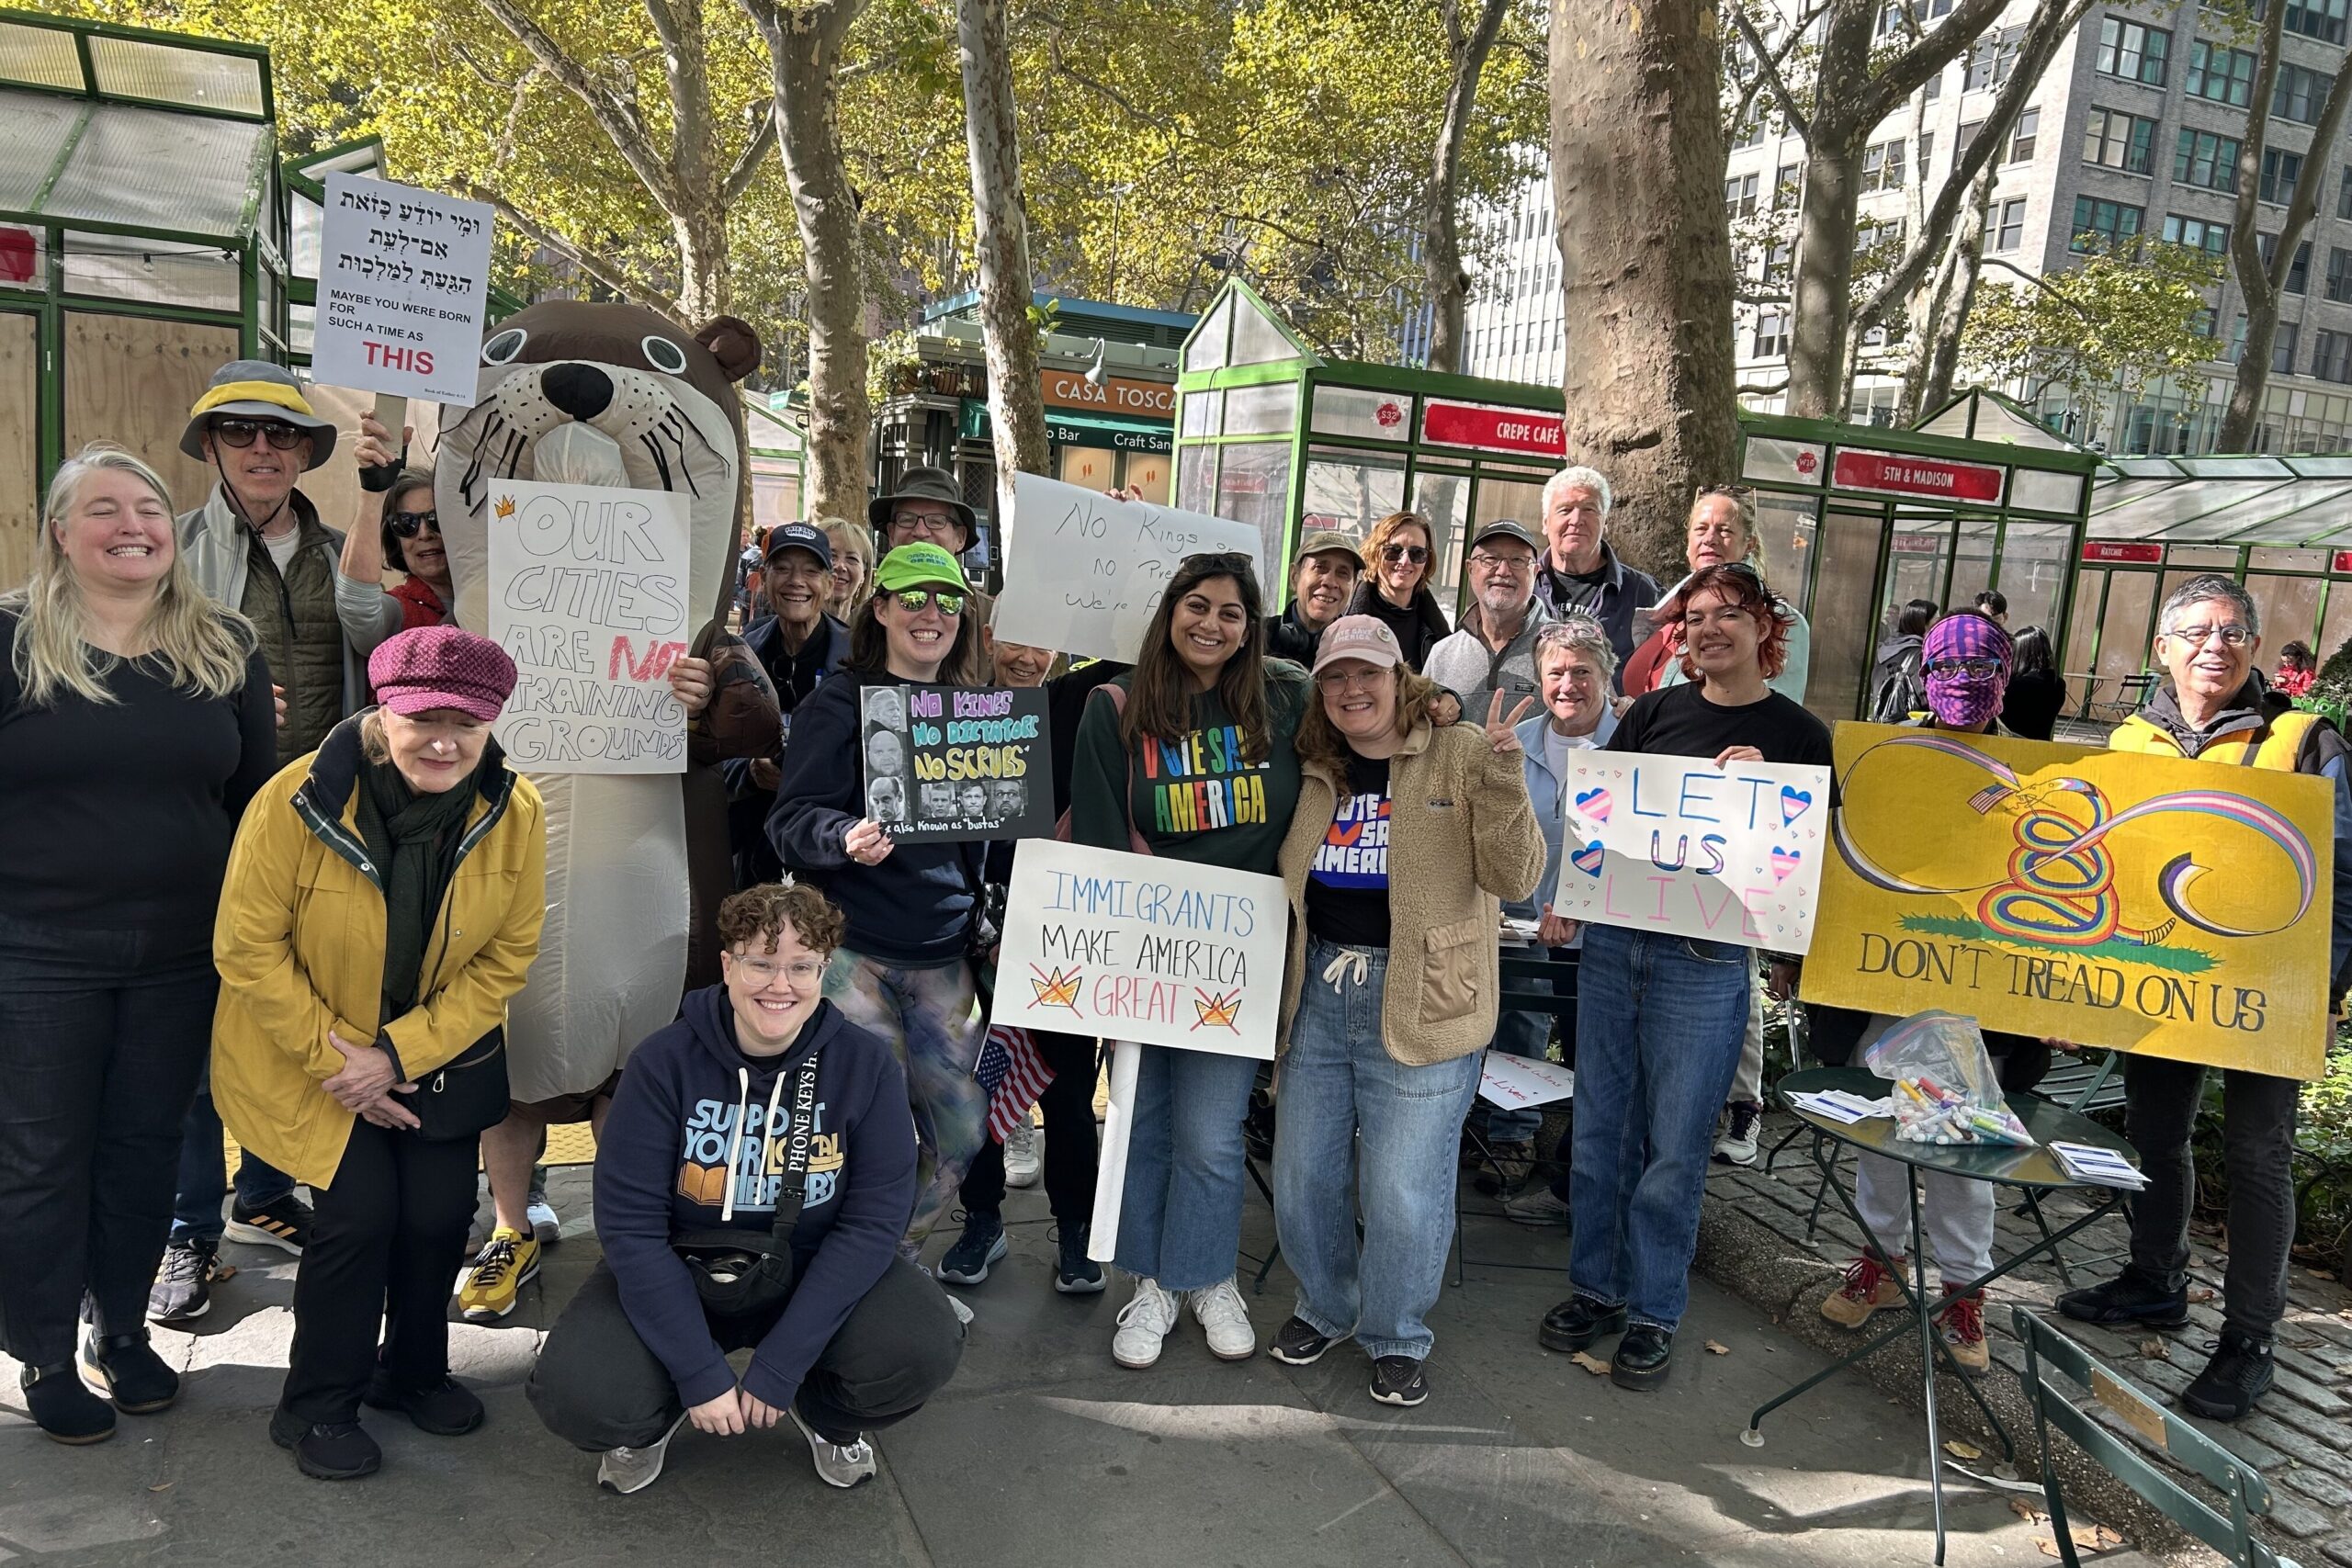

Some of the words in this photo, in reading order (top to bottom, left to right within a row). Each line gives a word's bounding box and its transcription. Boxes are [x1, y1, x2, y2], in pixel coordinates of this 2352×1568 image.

[329, 302, 356, 315] FOR
[331, 289, 371, 305] MAYBE
[374, 298, 399, 310] YOU
[402, 303, 435, 317] WERE
[439, 310, 471, 323] BORN
[328, 317, 362, 331] SUCH
[365, 323, 374, 333] A
[377, 324, 404, 338] TIME
[407, 331, 424, 342] AS
[362, 341, 435, 375] THIS
[1056, 380, 1107, 403] CASA
[1058, 427, 1080, 441] Bar
[1381, 411, 1397, 421] S32
[1497, 422, 1530, 441] CREPE
[1532, 425, 1559, 445] CAFÉ
[1114, 434, 1146, 448] Craft
[1148, 437, 1173, 450] San
[1883, 466, 1902, 482] 5TH
[1904, 469, 1911, 483] &
[1913, 469, 1954, 488] MADISON
[517, 494, 664, 564] OUR
[1055, 499, 1107, 538] No
[1137, 511, 1198, 553] Kings
[1137, 559, 1176, 580] Pre
[504, 565, 685, 636] CITIES
[1065, 589, 1128, 612] We're
[503, 624, 595, 674] ARE
[608, 635, 688, 683] NOT
[508, 672, 684, 728] TRAINING
[911, 690, 943, 717] NO
[953, 690, 1013, 718] KINGS
[503, 717, 687, 764] GROUNDS
[912, 721, 941, 747] NO
[946, 715, 1040, 745] DICTATORS
[1207, 725, 1271, 773] SAV
[914, 752, 945, 781] NO
[1155, 775, 1266, 833] AMERICA
[1336, 794, 1380, 820] OTE
[1633, 767, 1775, 829] LET
[894, 822, 914, 834] also
[951, 821, 962, 829] as
[1651, 829, 1727, 874] US
[1043, 870, 1254, 937] IMMIGRANTS
[1605, 874, 1774, 940] LIVE
[1042, 924, 1120, 965] MAKE
[1136, 933, 1248, 987] AMERICA
[1092, 975, 1185, 1024] GREAT
[1856, 931, 1994, 990] DON'T
[2004, 953, 2124, 1010] TREAD
[2135, 974, 2197, 1023] ON
[2211, 983, 2267, 1033] US
[797, 1071, 816, 1111] KEYS
[686, 1099, 826, 1135] SUPPOT
[684, 1126, 763, 1176] YOUR
[788, 1113, 810, 1173] PHONE
